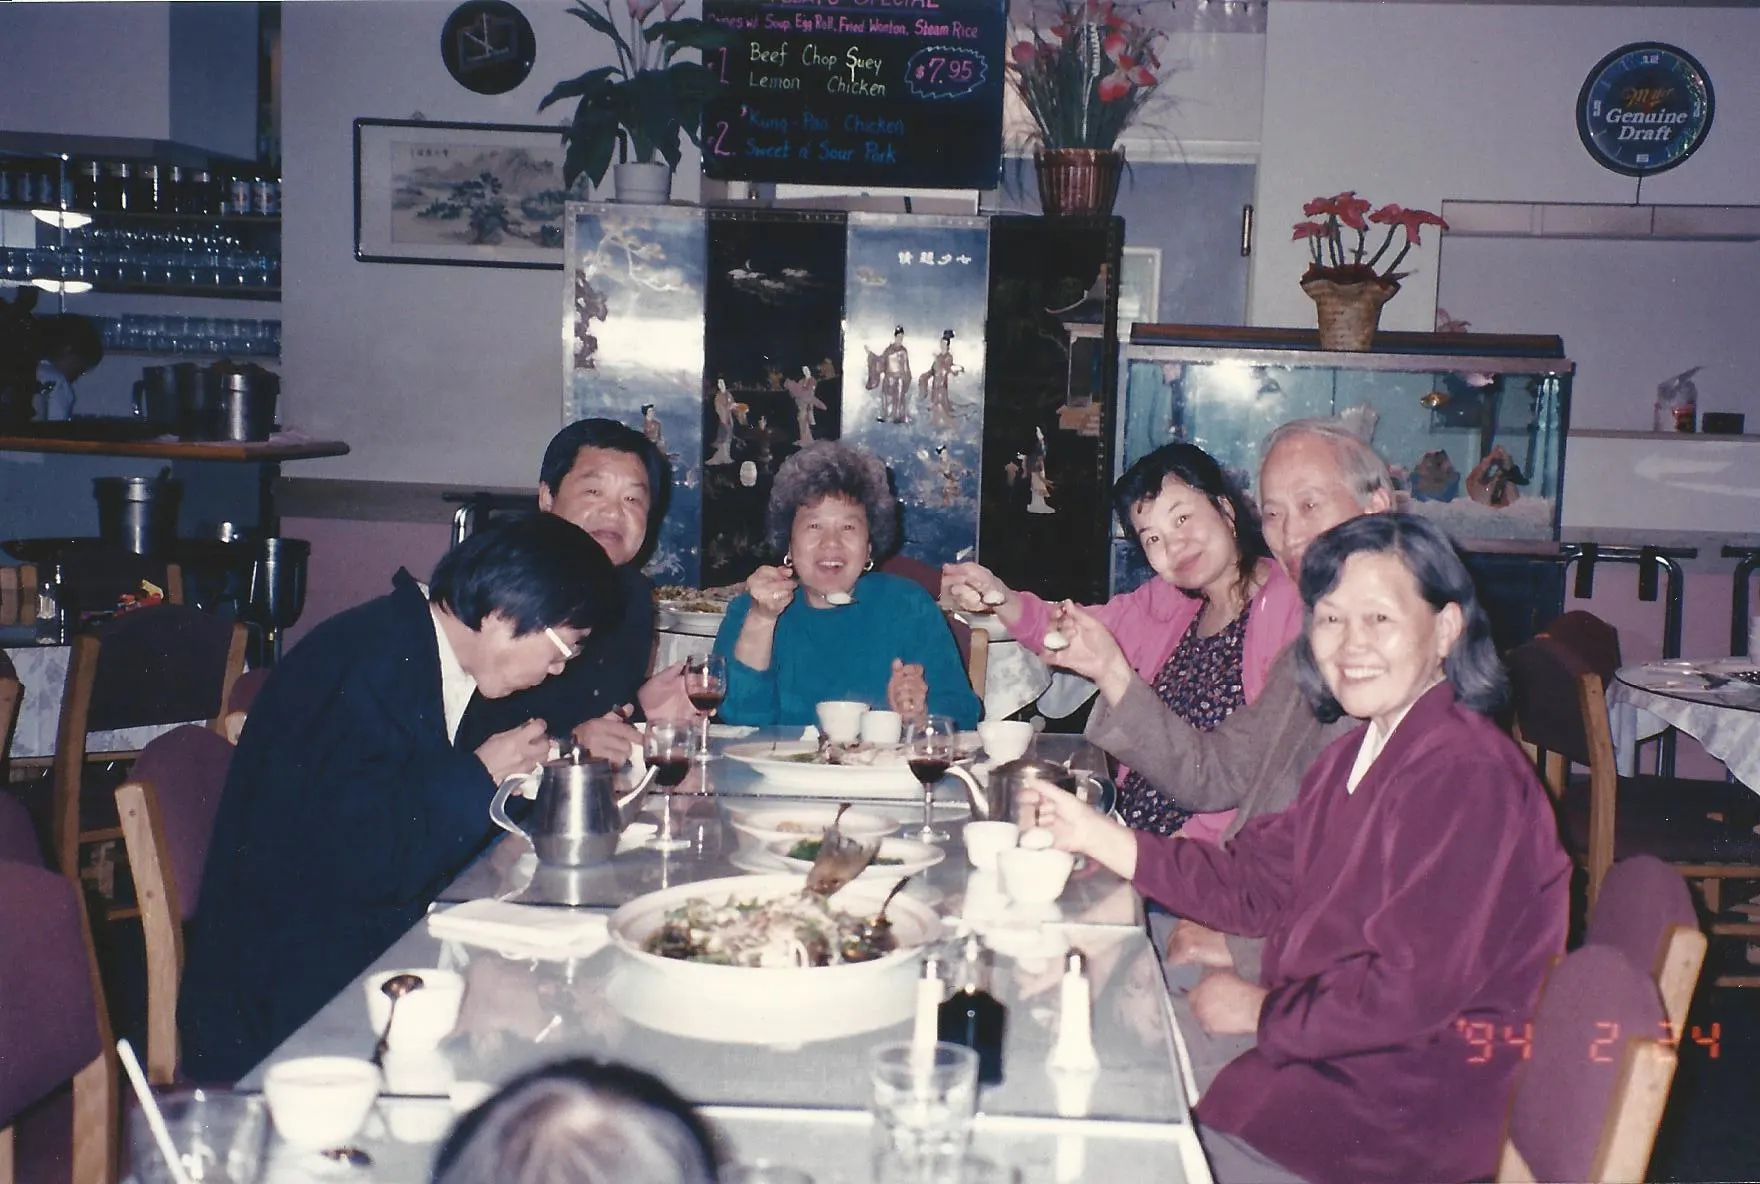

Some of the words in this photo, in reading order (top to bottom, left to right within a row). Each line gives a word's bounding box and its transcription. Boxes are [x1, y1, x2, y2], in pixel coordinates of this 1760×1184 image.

[764, 14, 790, 31] Soup
[795, 13, 813, 32] Egg
[838, 16, 864, 33] Fried
[914, 18, 949, 36] Steam
[952, 20, 978, 39] Rice
[750, 42, 788, 65] Beef
[802, 44, 837, 69] Chop
[846, 46, 882, 79] Suey
[915, 57, 973, 84] $7.95
[749, 75, 800, 90] Lemon
[827, 76, 886, 96] Chicken
[844, 113, 904, 135] Chicken
[1606, 108, 1688, 124] Genuine
[1617, 125, 1673, 140] Draft
[746, 137, 790, 159] Sweet
[818, 138, 855, 161] Sour
[865, 140, 897, 163] Pork
